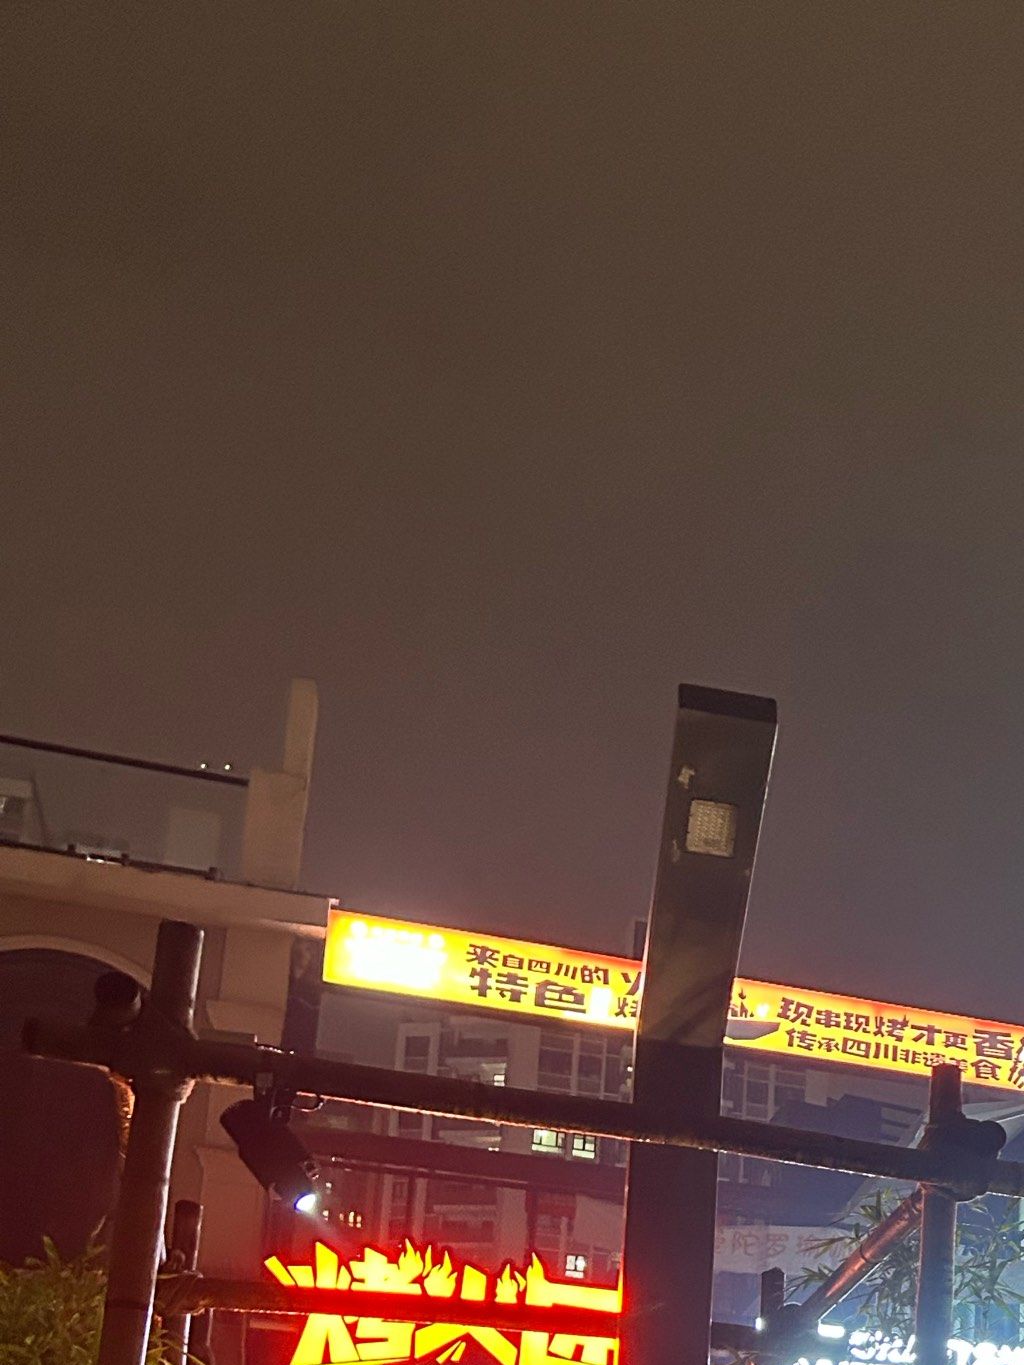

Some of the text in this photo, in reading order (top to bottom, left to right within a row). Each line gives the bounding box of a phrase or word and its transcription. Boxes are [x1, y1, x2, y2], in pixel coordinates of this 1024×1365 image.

[466, 943, 610, 986] 来自四川的
[469, 967, 587, 1014] 特色
[776, 996, 1015, 1061] 现串现烤才更香
